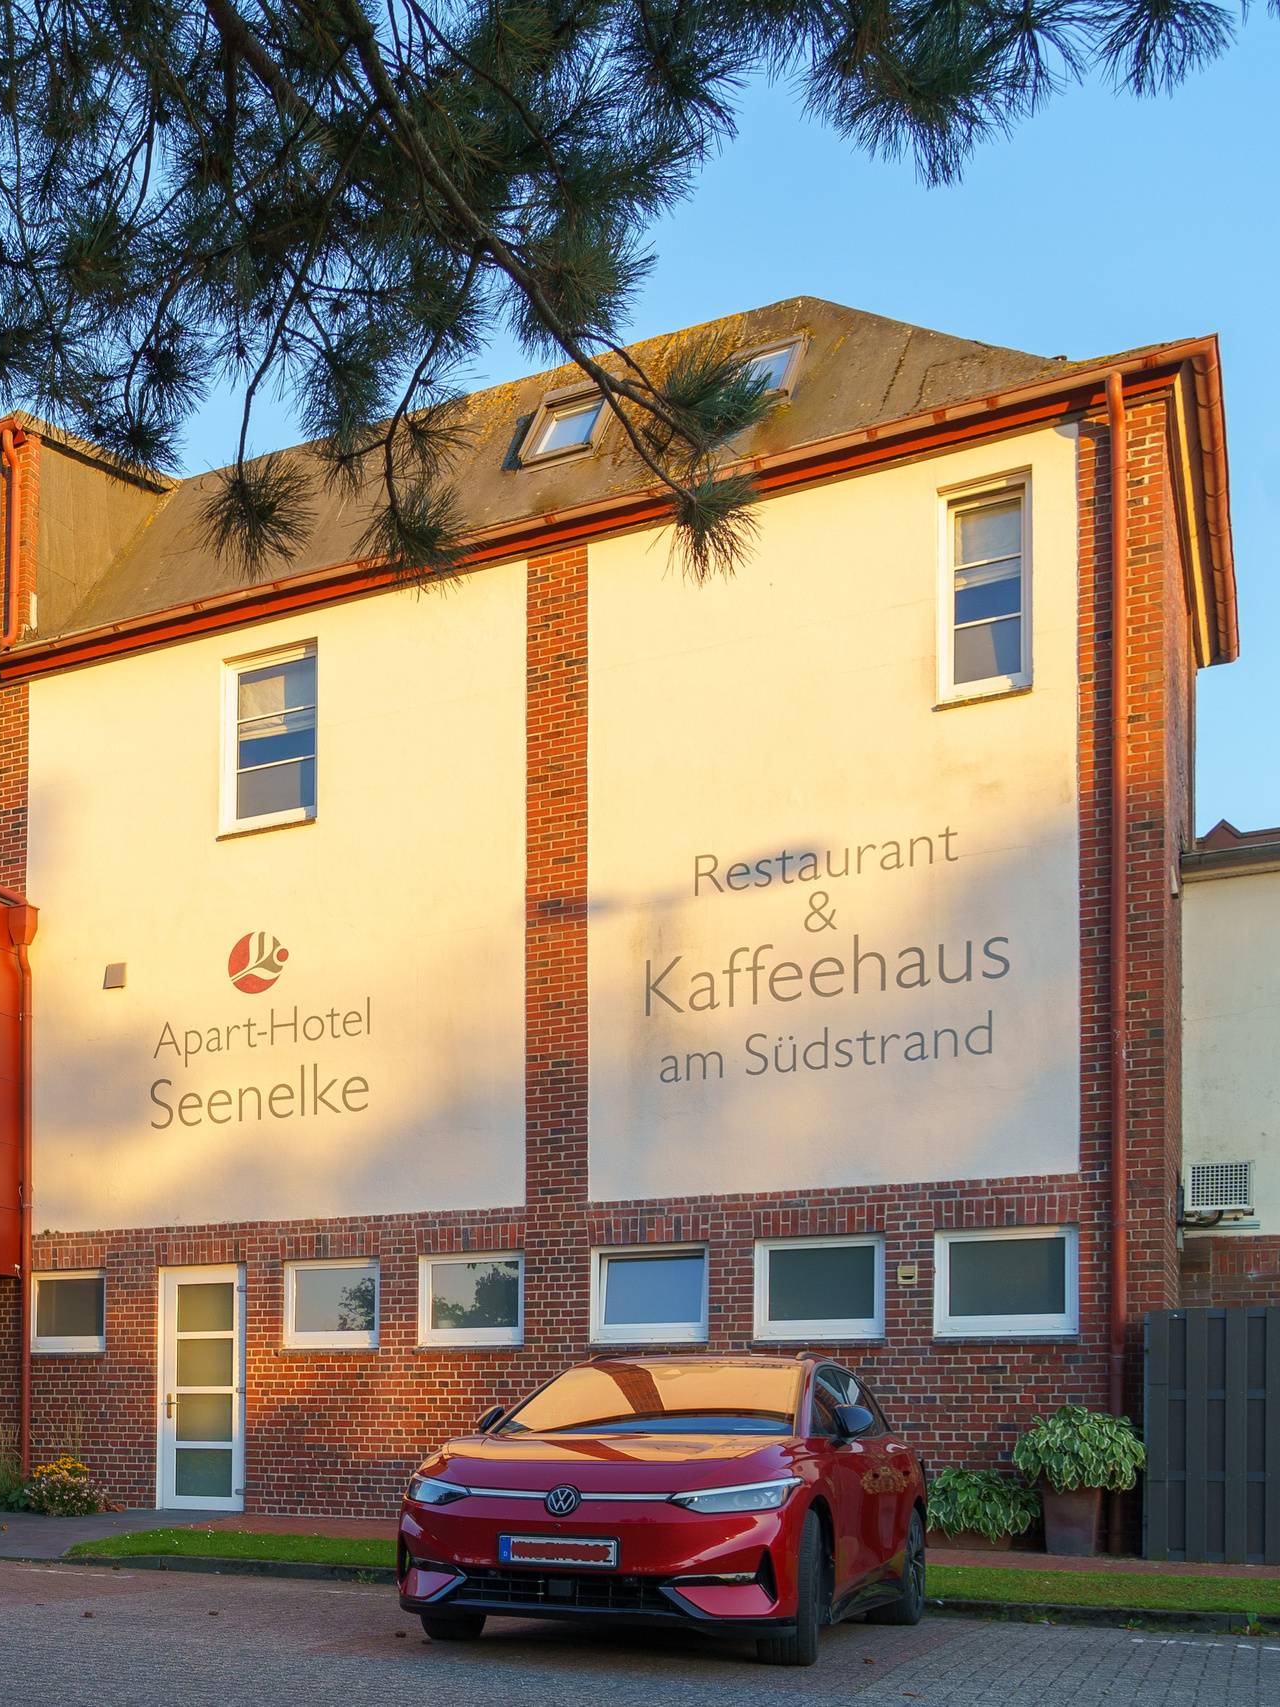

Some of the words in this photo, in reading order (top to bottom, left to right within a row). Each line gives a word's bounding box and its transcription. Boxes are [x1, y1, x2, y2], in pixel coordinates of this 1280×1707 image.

[694, 825, 958, 896] Restaurant
[803, 890, 838, 933] &
[645, 934, 1011, 1017] Kaffeehaus
[153, 996, 371, 1068] Apart-Hotel
[659, 1049, 724, 1083] am
[745, 1009, 993, 1076] Südstrand
[150, 1063, 369, 1130] Seenelke
